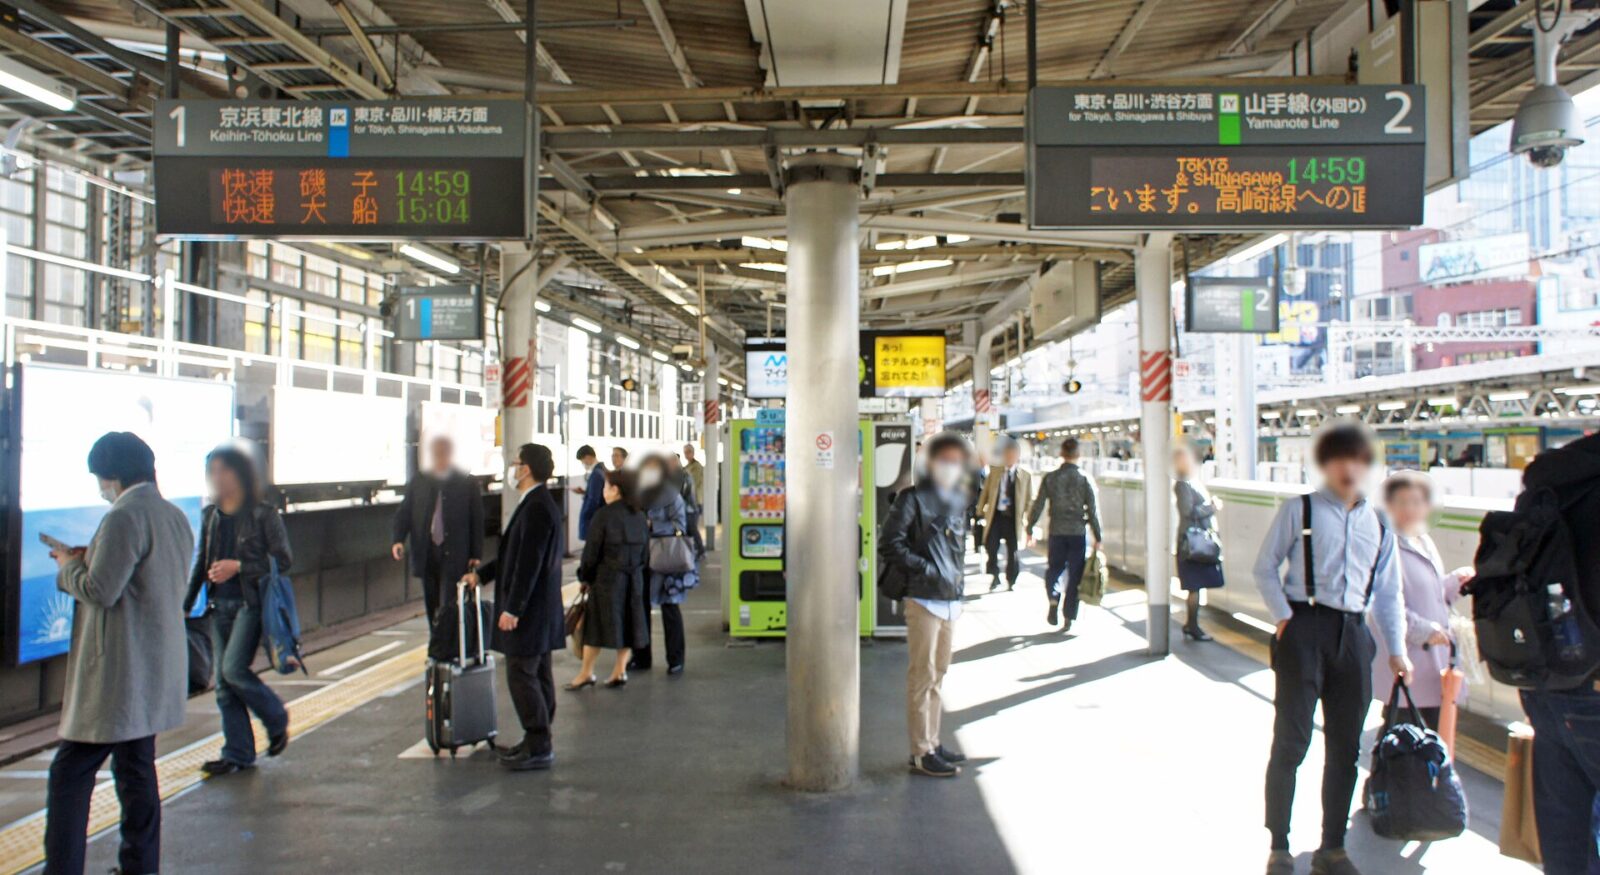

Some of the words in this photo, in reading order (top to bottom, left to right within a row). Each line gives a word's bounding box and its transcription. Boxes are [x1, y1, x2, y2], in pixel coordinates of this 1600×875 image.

[1074, 93, 1213, 110] 東京・品川・渋谷方面
[1244, 92, 1367, 115] 山手線(外回り)
[1384, 90, 1413, 134] 2
[219, 106, 323, 128] 京浜東北線
[354, 106, 488, 123] 東京・品川・横浜方面
[1069, 112, 1081, 122] for
[1115, 111, 1165, 123] Shinagawa
[1167, 112, 1174, 121] &
[1176, 111, 1213, 123] Shibuya
[1246, 116, 1310, 130] Yamanote
[1312, 116, 1340, 130] Line
[169, 106, 186, 147] 1
[297, 130, 323, 143] Line
[354, 124, 366, 134] for
[398, 125, 446, 136] Shinagawa
[447, 125, 455, 134] &
[457, 125, 503, 135] Yokohama
[1176, 172, 1189, 186] &
[1193, 171, 1283, 186] SHINAGAWA
[1287, 157, 1366, 185] 14:59
[221, 168, 274, 196] 快速
[395, 170, 471, 197] 14:59
[222, 194, 275, 224] 快速
[396, 198, 470, 224] 15:04
[406, 298, 416, 320] 1
[1255, 289, 1270, 312] 2
